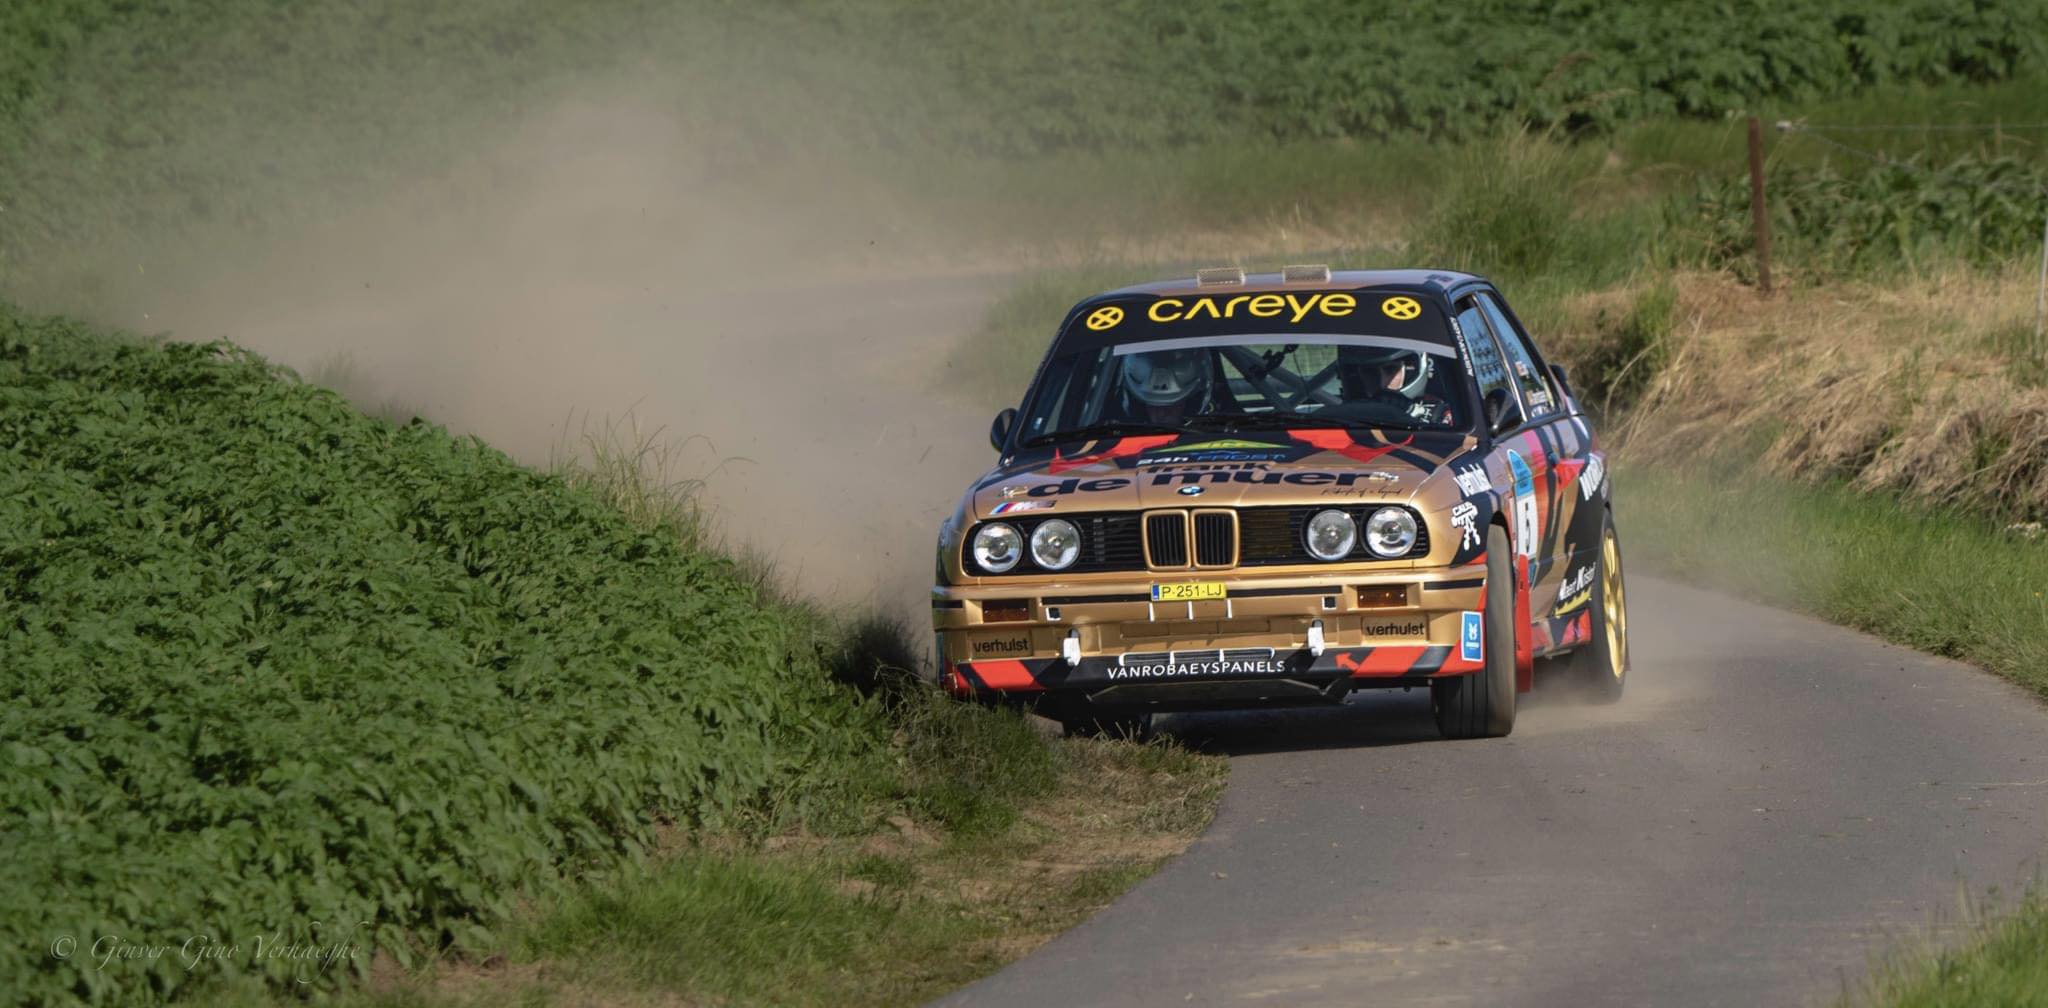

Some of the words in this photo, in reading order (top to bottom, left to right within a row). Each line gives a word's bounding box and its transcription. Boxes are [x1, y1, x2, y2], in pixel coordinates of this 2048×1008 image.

[1026, 477, 1132, 498] de
[1150, 471, 1371, 487] muer
[1366, 621, 1426, 637] verhulst
[972, 637, 1029, 653] verhulst
[1106, 660, 1287, 680] VANROBAEYSPANELS
